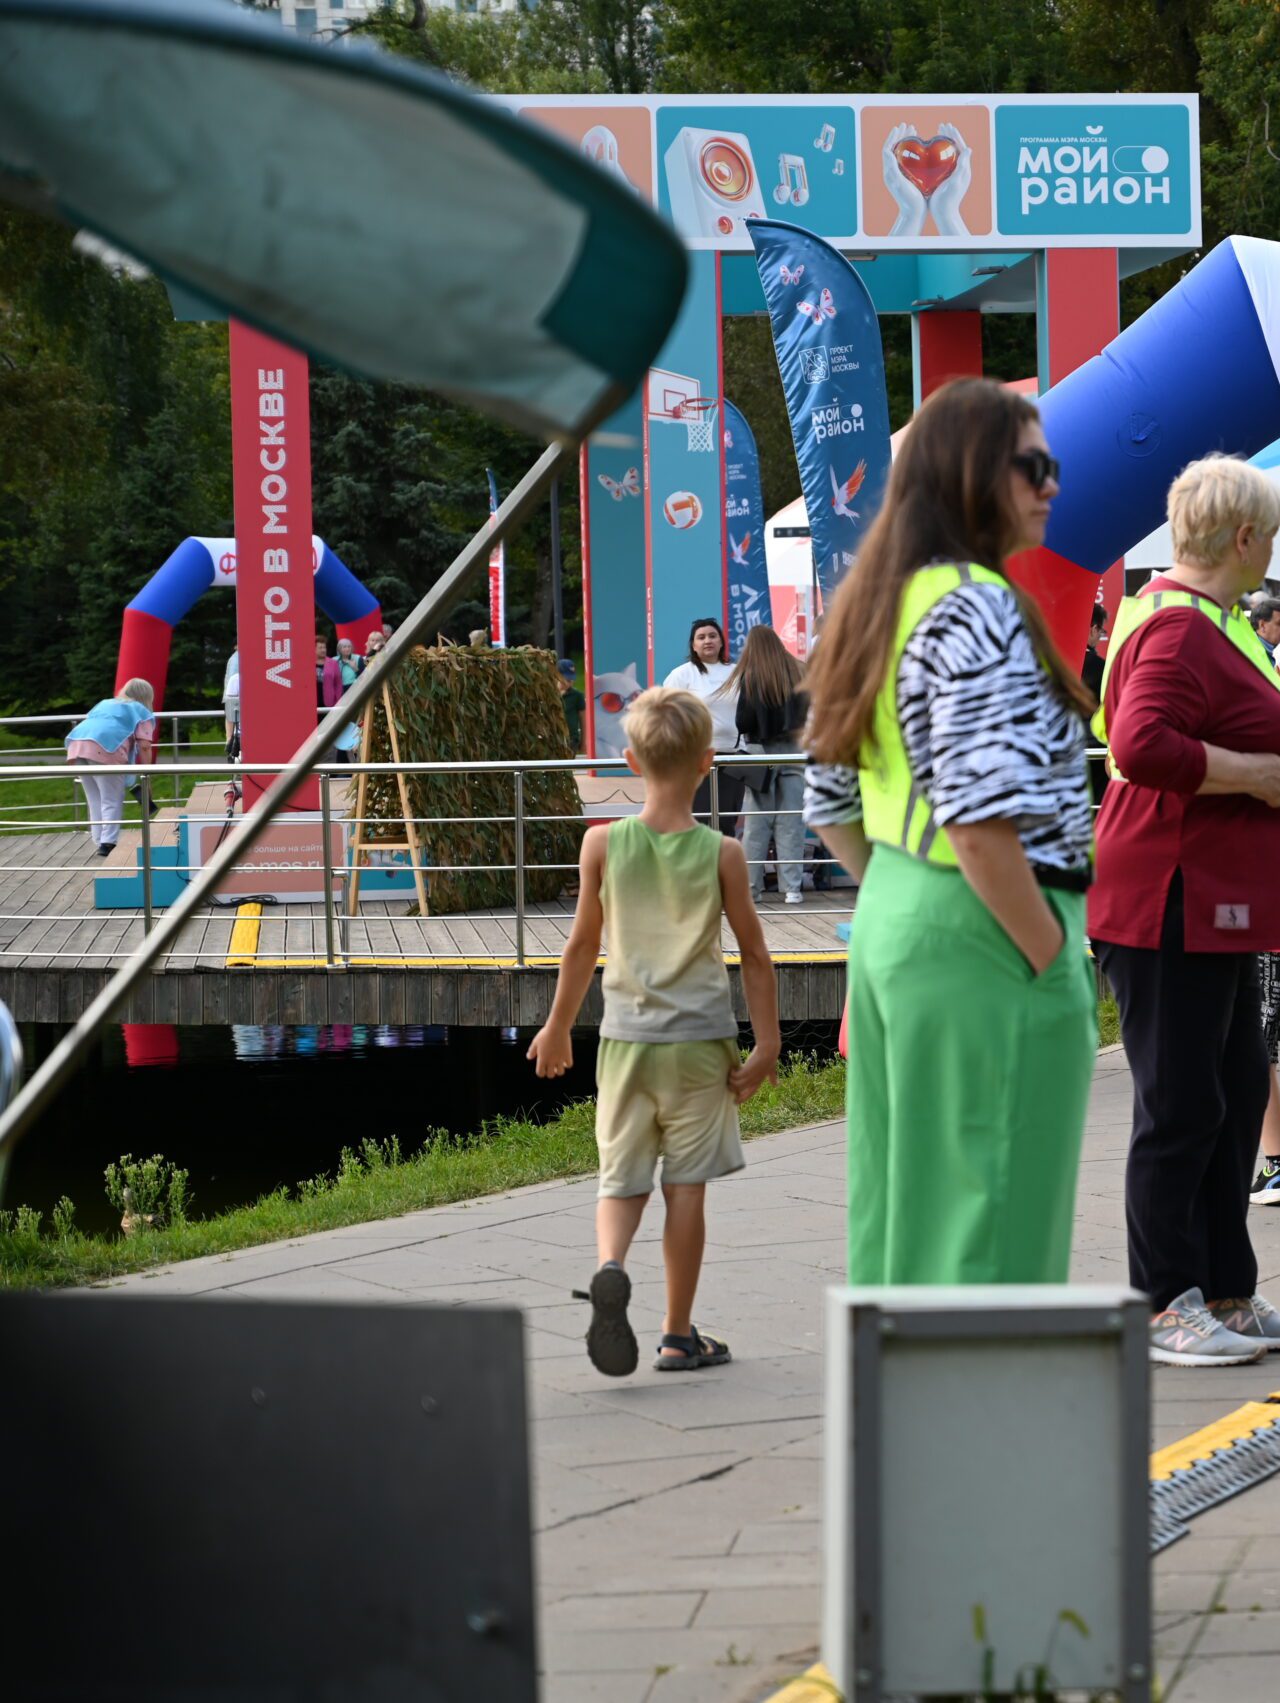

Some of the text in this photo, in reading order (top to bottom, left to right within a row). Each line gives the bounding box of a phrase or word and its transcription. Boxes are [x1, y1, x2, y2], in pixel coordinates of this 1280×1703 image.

[830, 345, 854, 355] ПРОЕКТ
[832, 362, 859, 373] МОСКВЫ
[258, 368, 291, 688] ЛЕТО В МОСКВЕ
